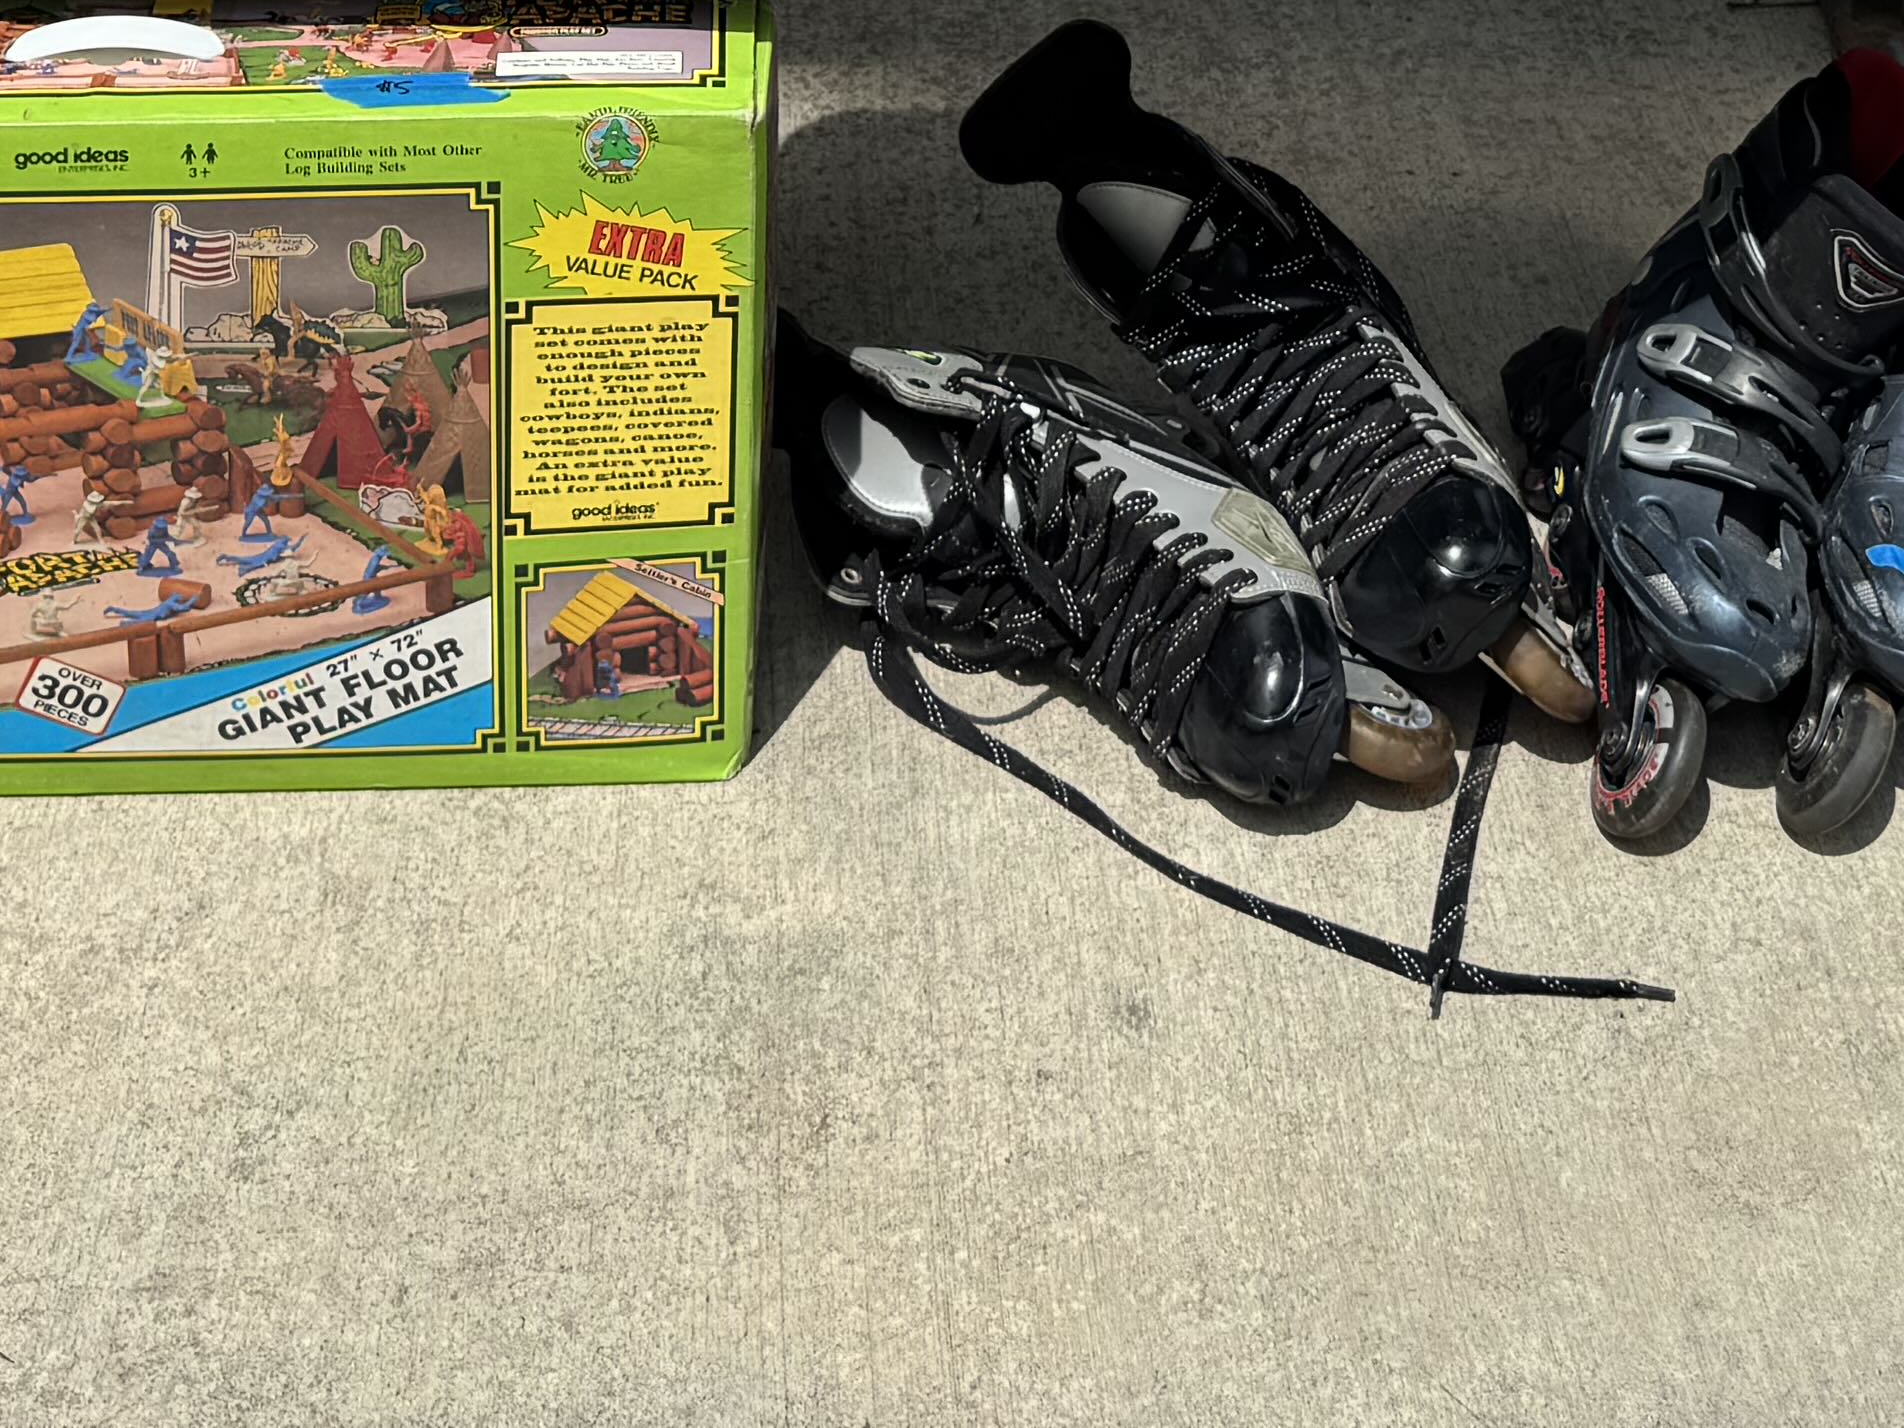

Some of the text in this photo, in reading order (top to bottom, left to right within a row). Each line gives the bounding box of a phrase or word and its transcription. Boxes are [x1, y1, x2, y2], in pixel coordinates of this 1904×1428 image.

[509, 3, 692, 25] APACHE
[15, 145, 129, 172] good ideas
[284, 143, 483, 162] Compatible with Most Other
[188, 167, 211, 179] 3+
[285, 160, 407, 178] Log Building Sets
[588, 219, 685, 268] EXTRA
[565, 254, 699, 292] VALUE PACK
[533, 321, 710, 336] This giant play
[537, 347, 701, 360] enough pieces
[536, 370, 707, 384] build your own
[544, 395, 693, 409] also includes
[527, 418, 713, 434] teepees, covered
[522, 443, 716, 459] horses and more.
[528, 466, 712, 483] is the giant play
[572, 504, 611, 520] good
[615, 502, 656, 515] ideas
[6, 552, 140, 594] APACHE
[634, 563, 712, 598] Settler's Cabin
[1596, 586, 1609, 707] ROLLERBLADE
[58, 667, 103, 691] OVER
[231, 630, 424, 711] Colorful 27" 72"
[31, 673, 109, 718] 300
[217, 637, 464, 741] GIANT FLOOR
[33, 699, 89, 727] PIECES
[286, 665, 459, 744] PLAY MAT
